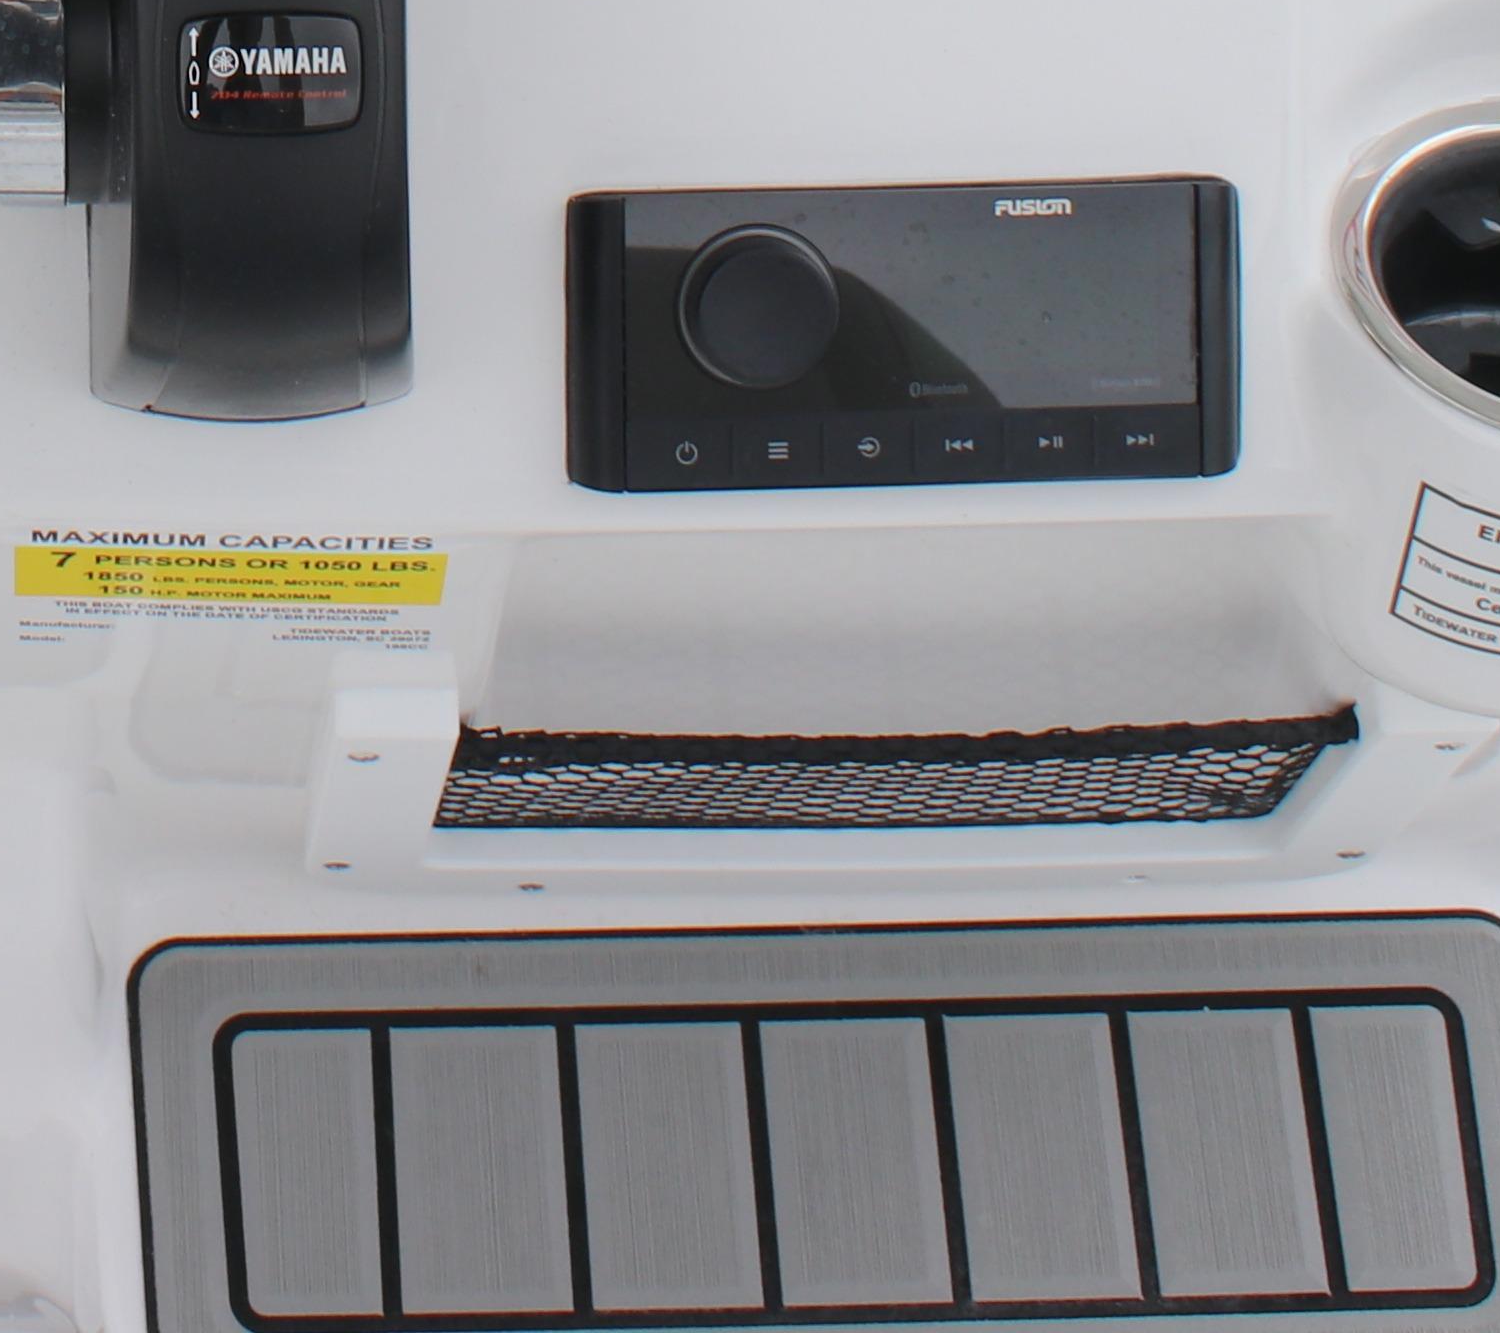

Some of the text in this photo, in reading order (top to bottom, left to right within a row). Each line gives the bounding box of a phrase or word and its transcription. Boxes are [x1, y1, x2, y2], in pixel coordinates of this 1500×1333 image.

[240, 47, 346, 75] YAMAHA
[31, 530, 433, 550] MAXIMUM CAPACITIES
[51, 551, 436, 572] 7 PERSONS OR 1050 LBS.
[84, 571, 143, 581] 1850
[1416, 555, 1443, 575] This
[1446, 570, 1487, 591] vessel
[99, 585, 143, 595] 150
[187, 590, 246, 598] MOTOR
[252, 592, 332, 600] MAXIMUM
[92, 601, 131, 609] BOAT
[138, 602, 215, 611] COMPLIES
